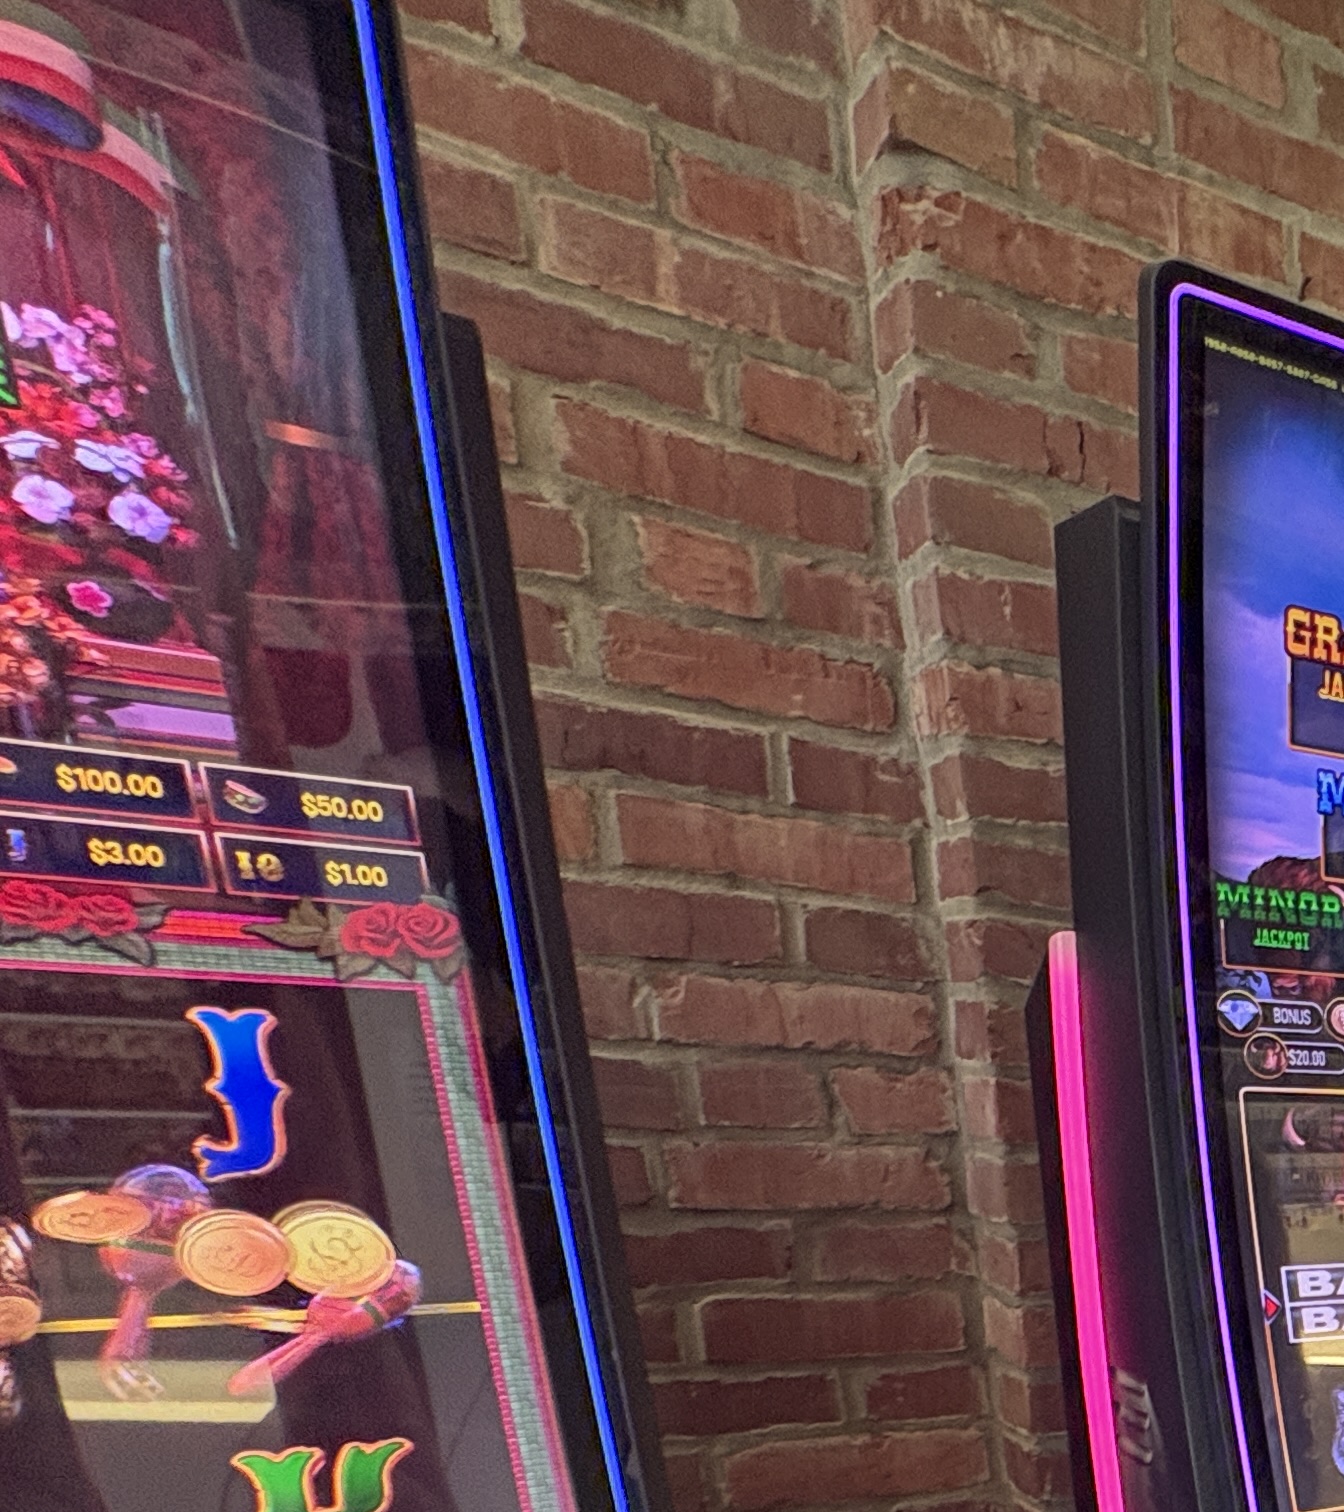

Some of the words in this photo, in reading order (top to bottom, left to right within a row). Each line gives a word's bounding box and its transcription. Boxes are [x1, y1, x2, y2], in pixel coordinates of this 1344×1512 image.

[55, 763, 164, 799] $100.00
[301, 792, 384, 823] $50.00
[87, 837, 166, 868] $3.00
[324, 859, 389, 888] $1.00
[1216, 882, 1344, 929] MINOR
[1254, 928, 1310, 951] JACKPOT
[1273, 1007, 1311, 1026] BONUS
[1288, 1050, 1326, 1068] $20.00
[185, 1005, 292, 1183] J
